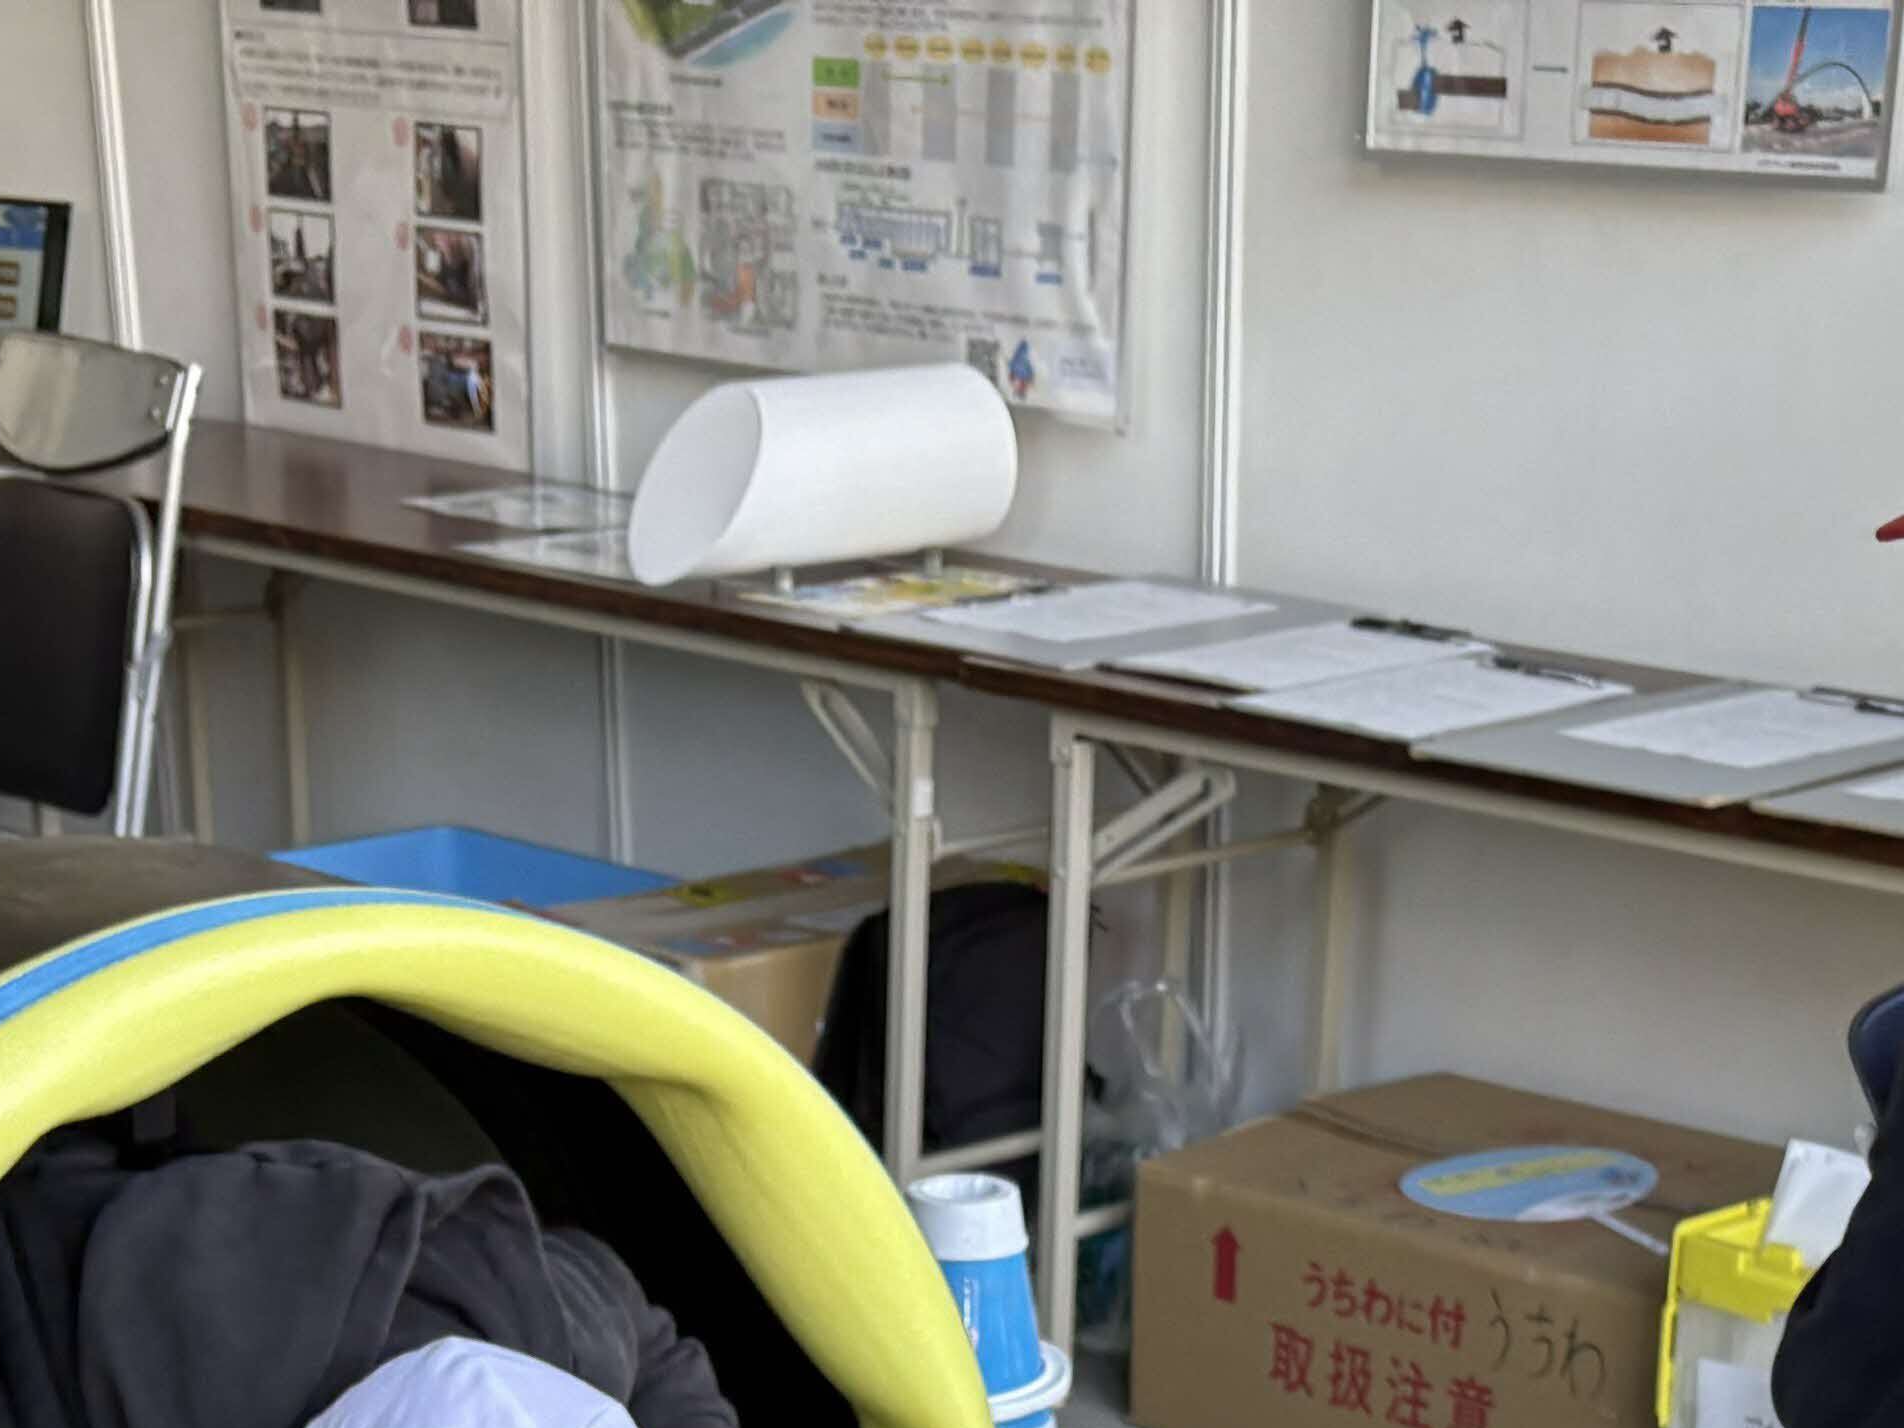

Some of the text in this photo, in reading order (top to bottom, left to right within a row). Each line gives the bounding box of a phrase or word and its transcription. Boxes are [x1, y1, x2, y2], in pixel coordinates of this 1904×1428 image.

[1302, 1260, 1466, 1349] うちわに付
